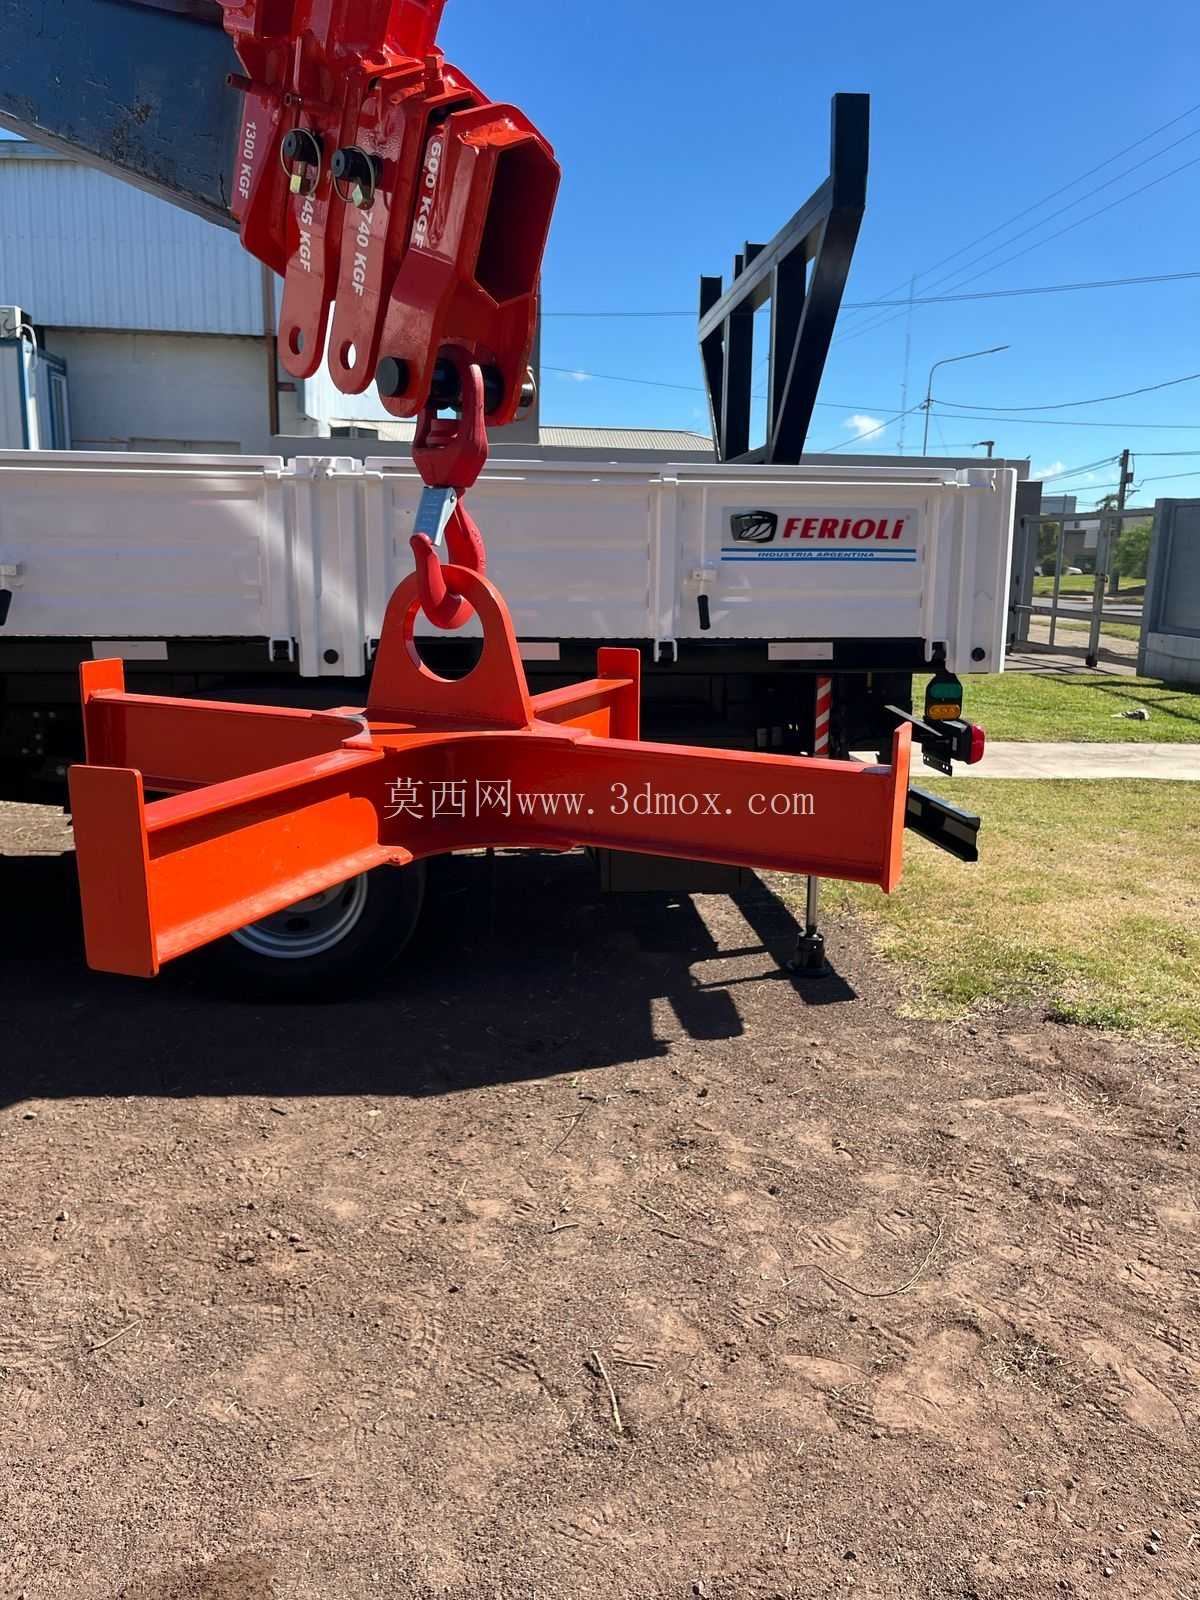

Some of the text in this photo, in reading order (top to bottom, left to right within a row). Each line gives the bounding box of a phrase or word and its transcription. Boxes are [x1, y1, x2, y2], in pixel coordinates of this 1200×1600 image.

[238, 120, 257, 200] 1300 KGF
[414, 142, 442, 249] 600 KGF
[299, 229, 312, 273] KGF
[351, 209, 374, 297] 740 KGF
[816, 551, 875, 559] ARGENTINA
